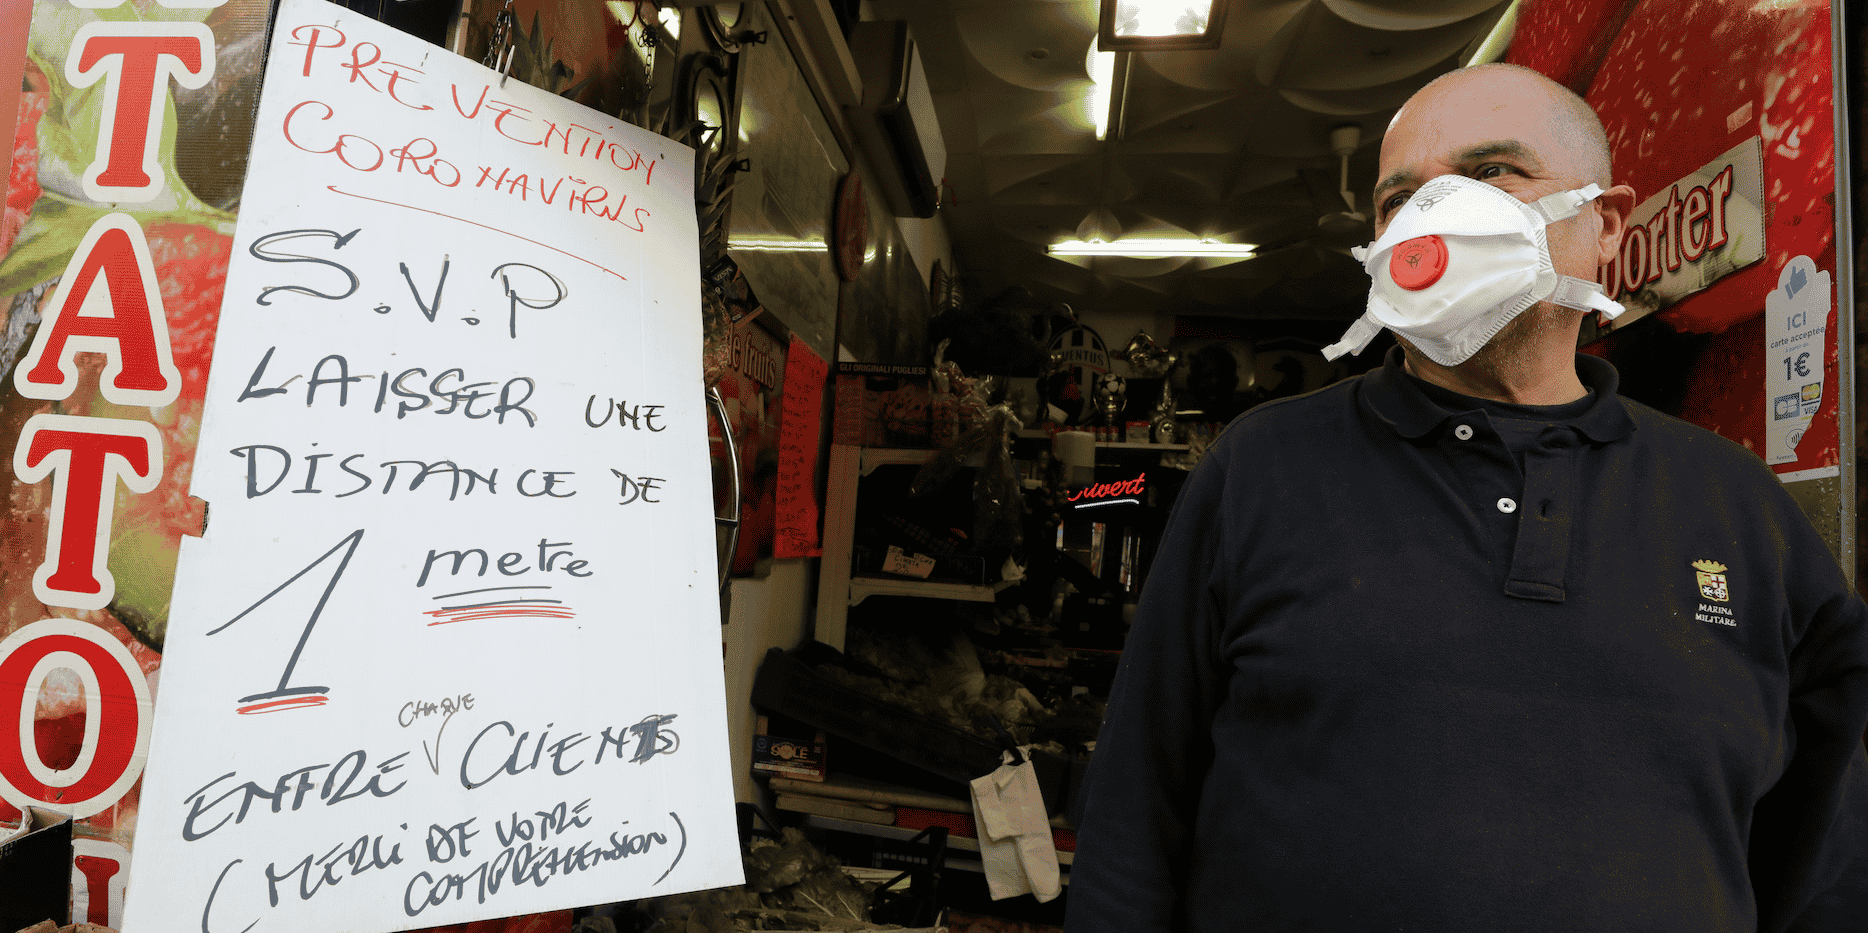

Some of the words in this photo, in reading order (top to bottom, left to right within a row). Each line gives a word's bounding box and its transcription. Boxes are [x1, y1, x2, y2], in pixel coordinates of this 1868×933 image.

[1787, 311, 1807, 331] ICI
[1770, 337, 1789, 350] carte
[1790, 325, 1826, 343] acceptée
[743, 333, 777, 391] fruits
[1783, 351, 1811, 382] 1€
[585, 394, 668, 433] UNE
[230, 442, 577, 502] DISTANCE
[610, 468, 668, 506] DE
[205, 528, 366, 703] 1
[1694, 612, 1738, 628] MILITARE
[1697, 602, 1734, 617] MARINA
[770, 742, 809, 760] SOLE
